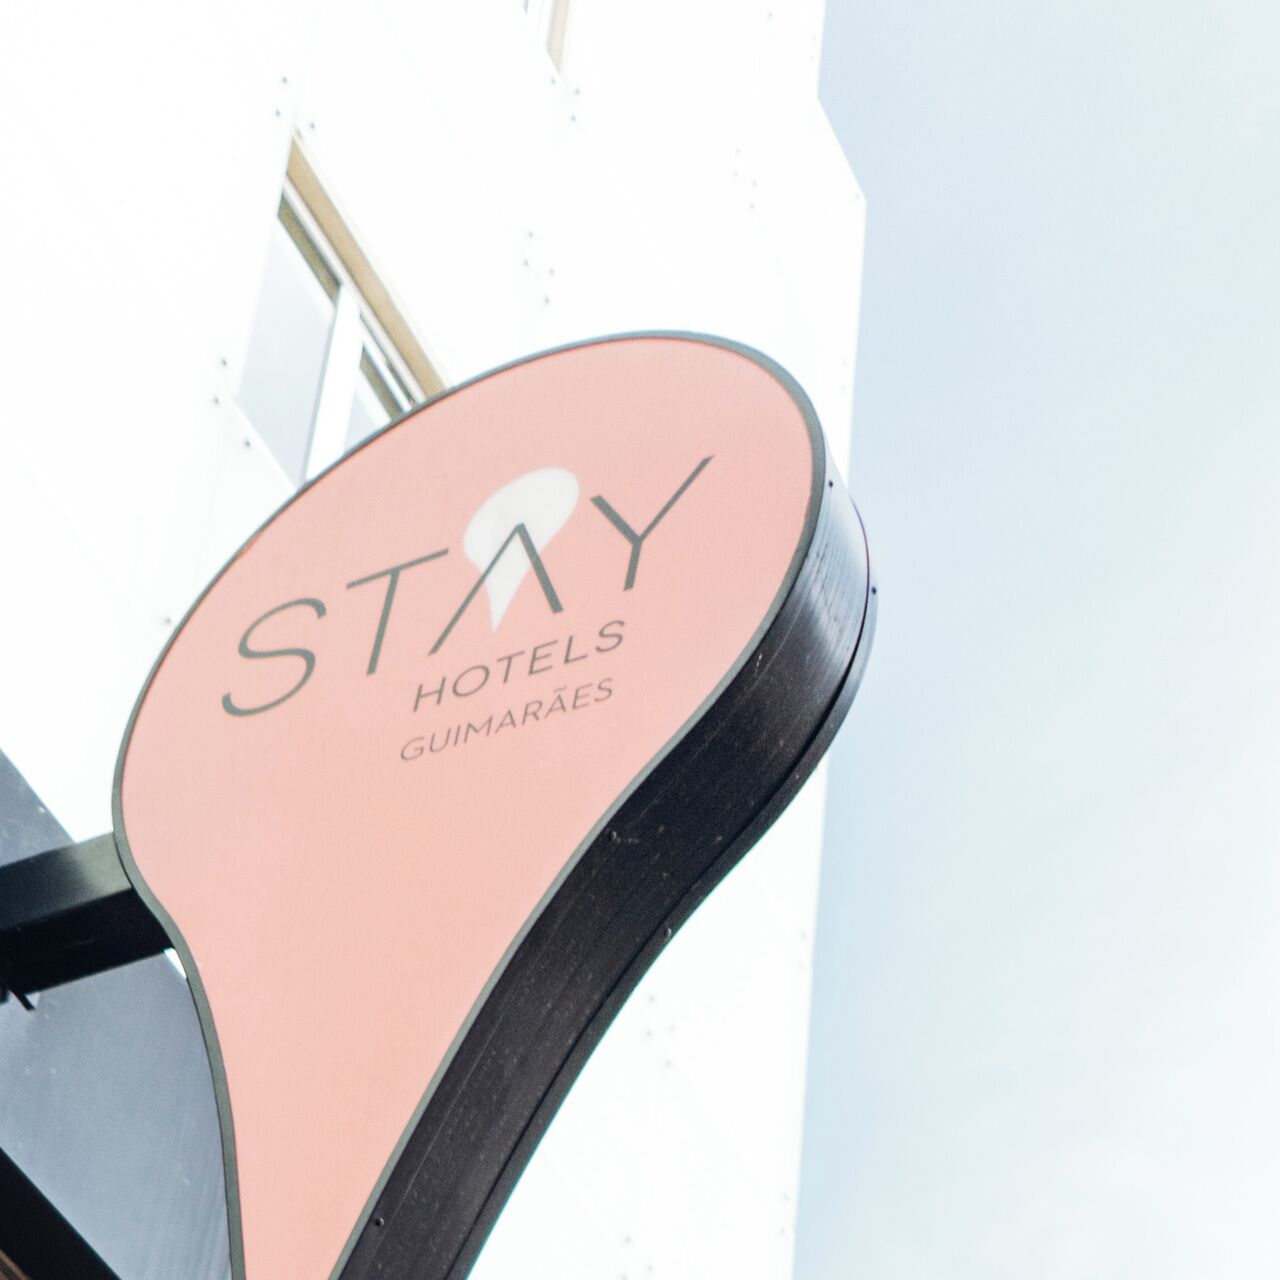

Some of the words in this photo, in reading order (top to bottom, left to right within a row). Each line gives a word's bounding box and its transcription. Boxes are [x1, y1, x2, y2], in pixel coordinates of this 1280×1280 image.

[221, 455, 715, 718] STAY
[412, 619, 626, 713] HOTELS
[399, 677, 614, 761] GUIMARÃES
